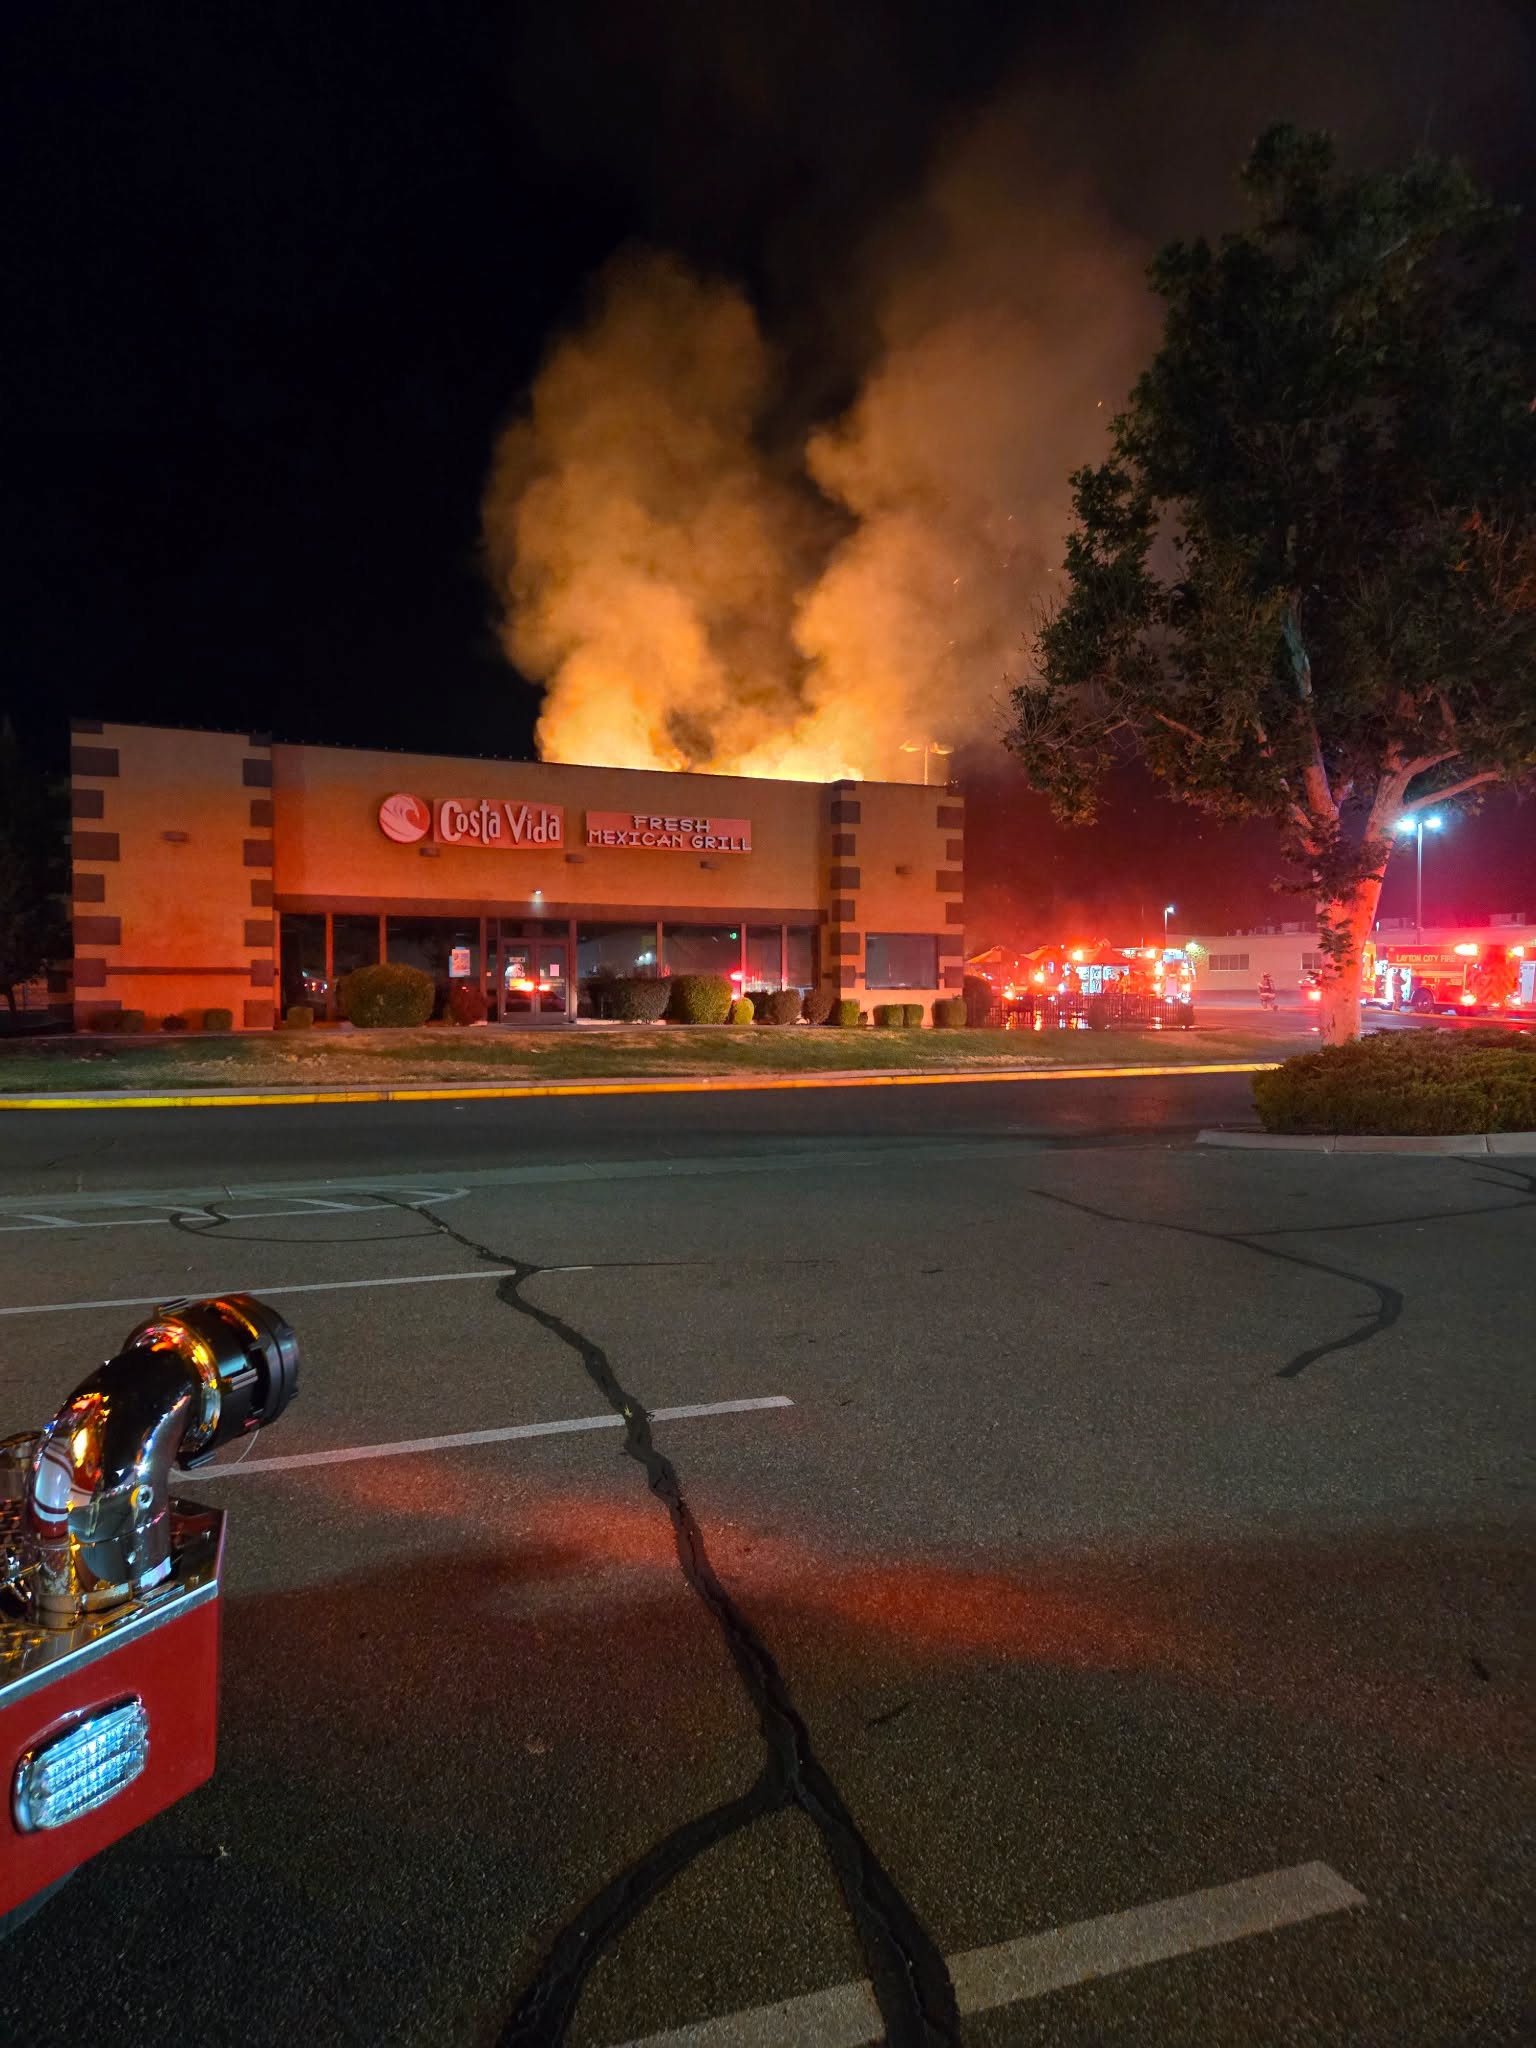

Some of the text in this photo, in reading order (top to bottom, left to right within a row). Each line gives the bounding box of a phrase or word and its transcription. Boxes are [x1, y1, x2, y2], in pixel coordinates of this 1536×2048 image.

[440, 799, 560, 844] Costa Vida
[633, 815, 711, 833] FRESH
[588, 830, 752, 850] MEXICAN GRILL
[1423, 954, 1439, 962] CITY
